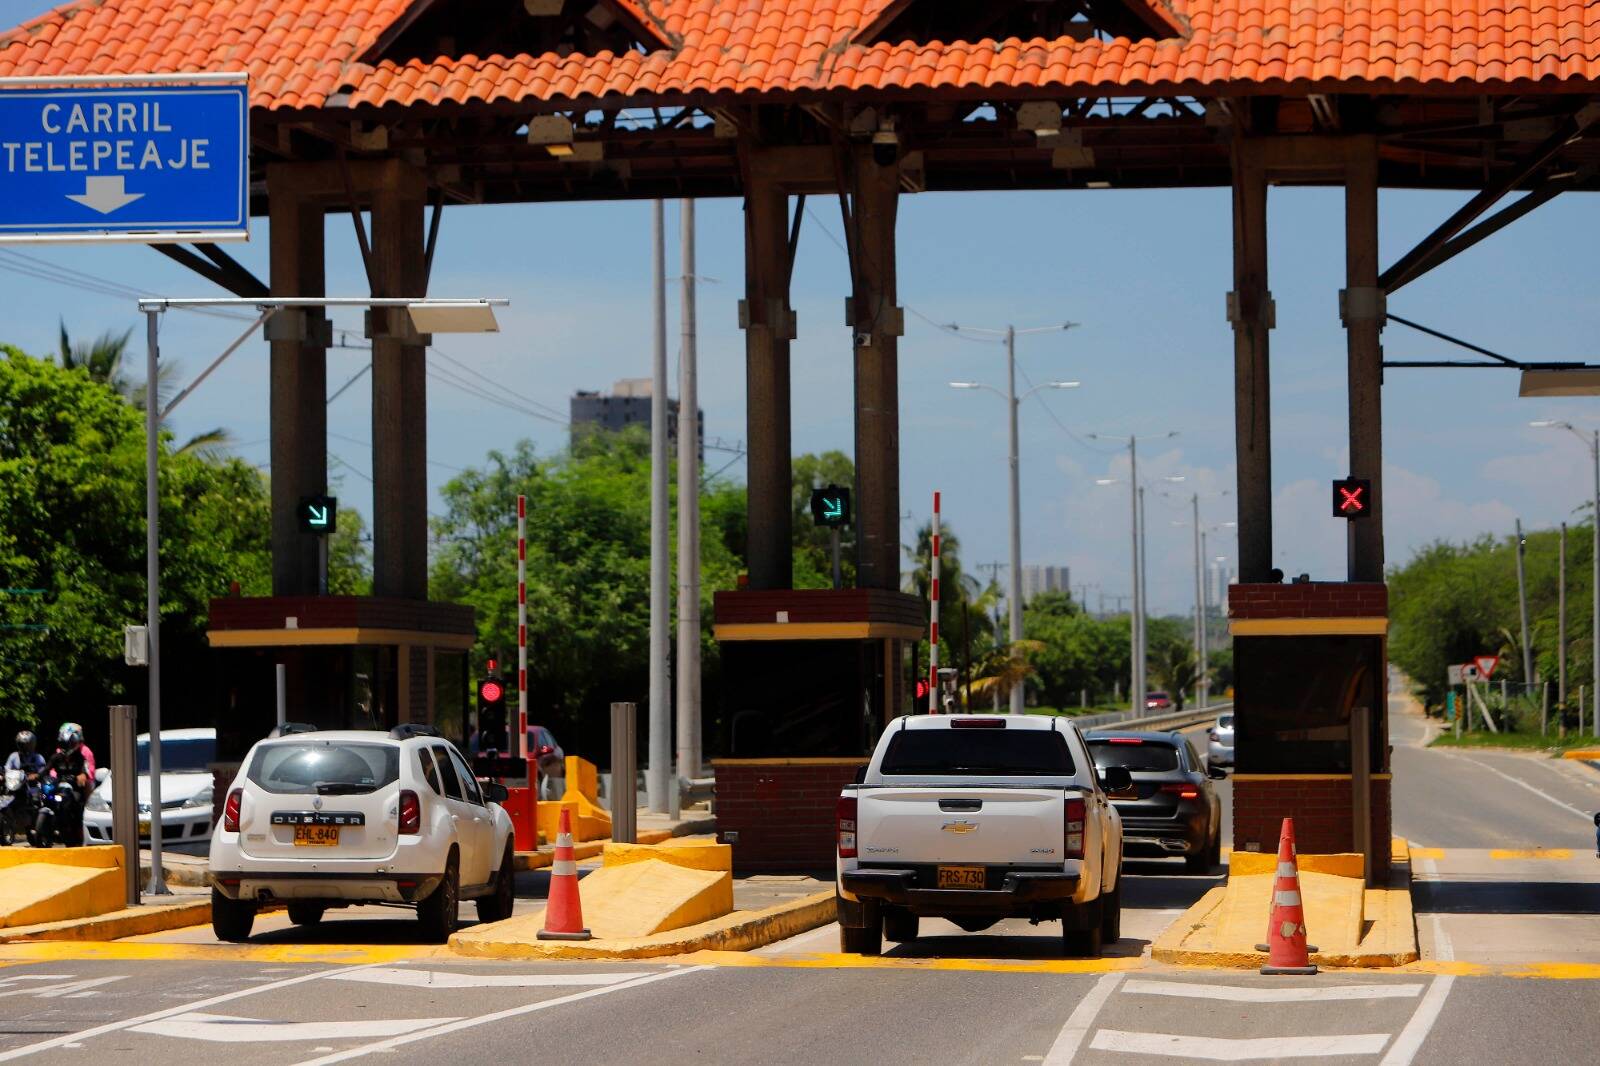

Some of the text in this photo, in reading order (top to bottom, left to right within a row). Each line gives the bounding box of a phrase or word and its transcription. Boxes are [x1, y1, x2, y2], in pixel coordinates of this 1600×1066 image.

[41, 102, 173, 134] CARRIL
[2, 138, 211, 173] TELEPEAJE
[273, 816, 361, 825] DUSTER
